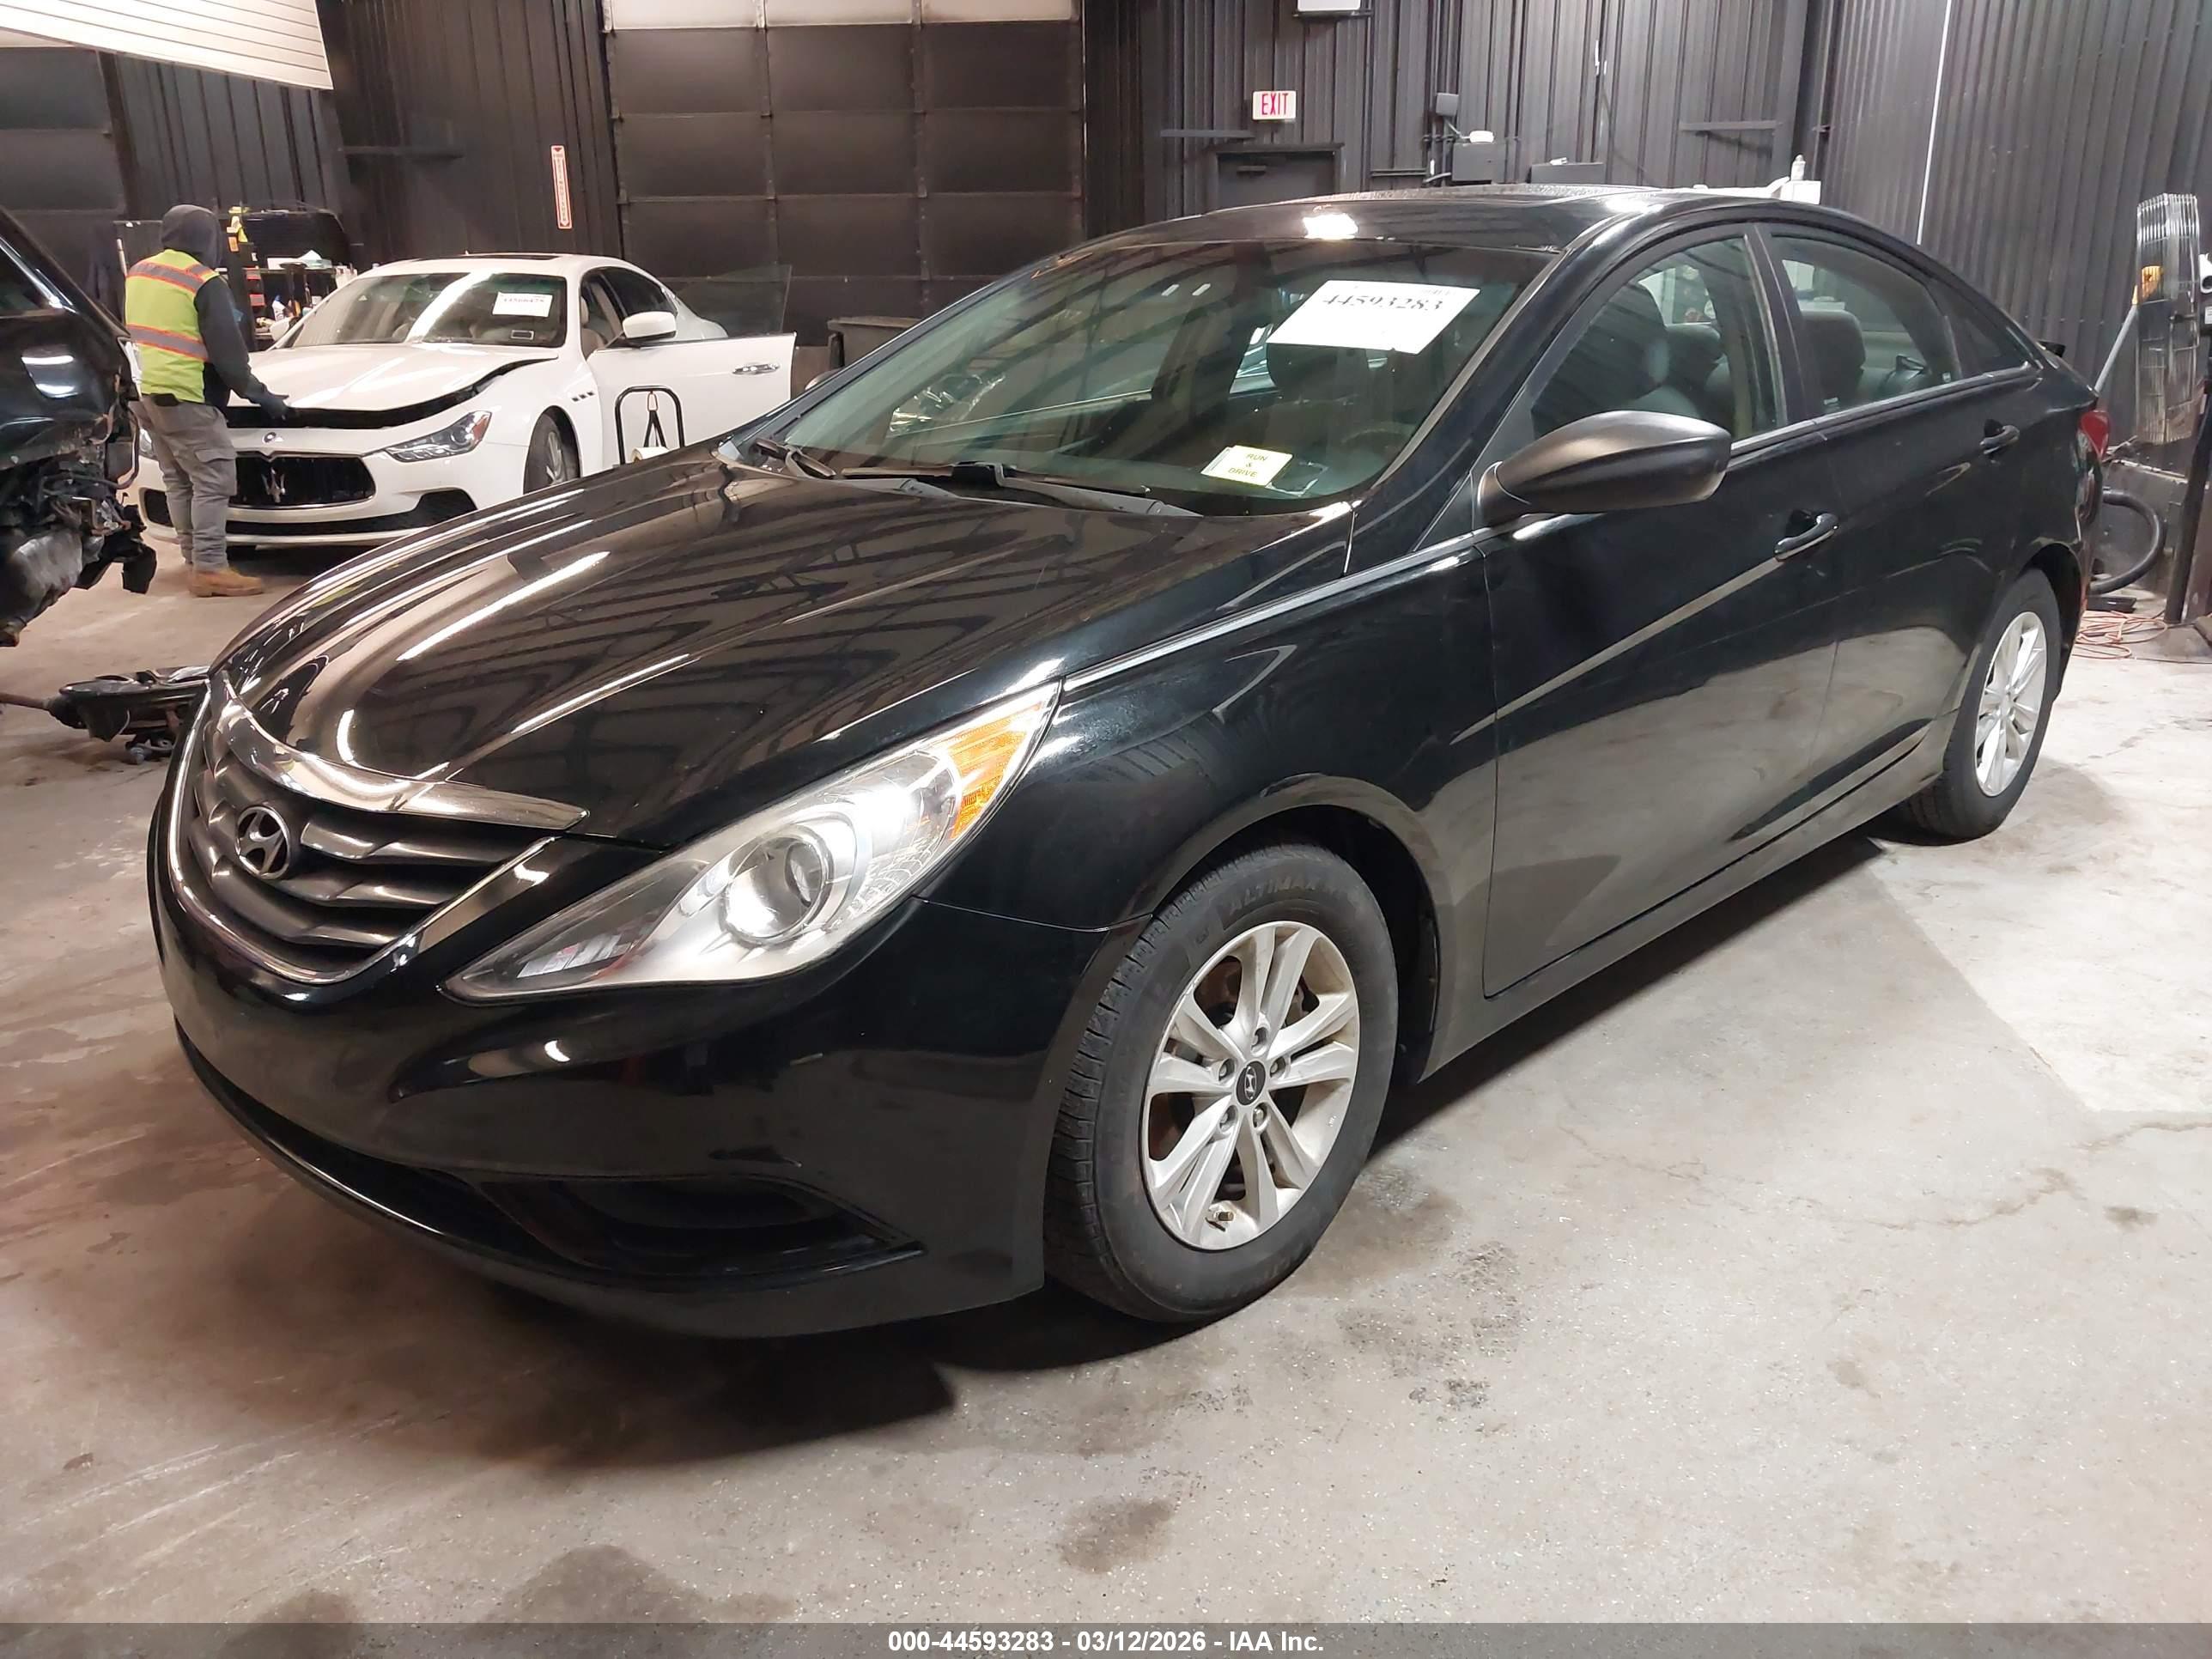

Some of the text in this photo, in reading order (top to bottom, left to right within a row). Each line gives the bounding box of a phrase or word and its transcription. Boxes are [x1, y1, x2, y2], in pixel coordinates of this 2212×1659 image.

[1261, 93, 1289, 115] EXIT
[1322, 295, 1443, 311] 44593283
[1228, 467, 1258, 477] DRIVE
